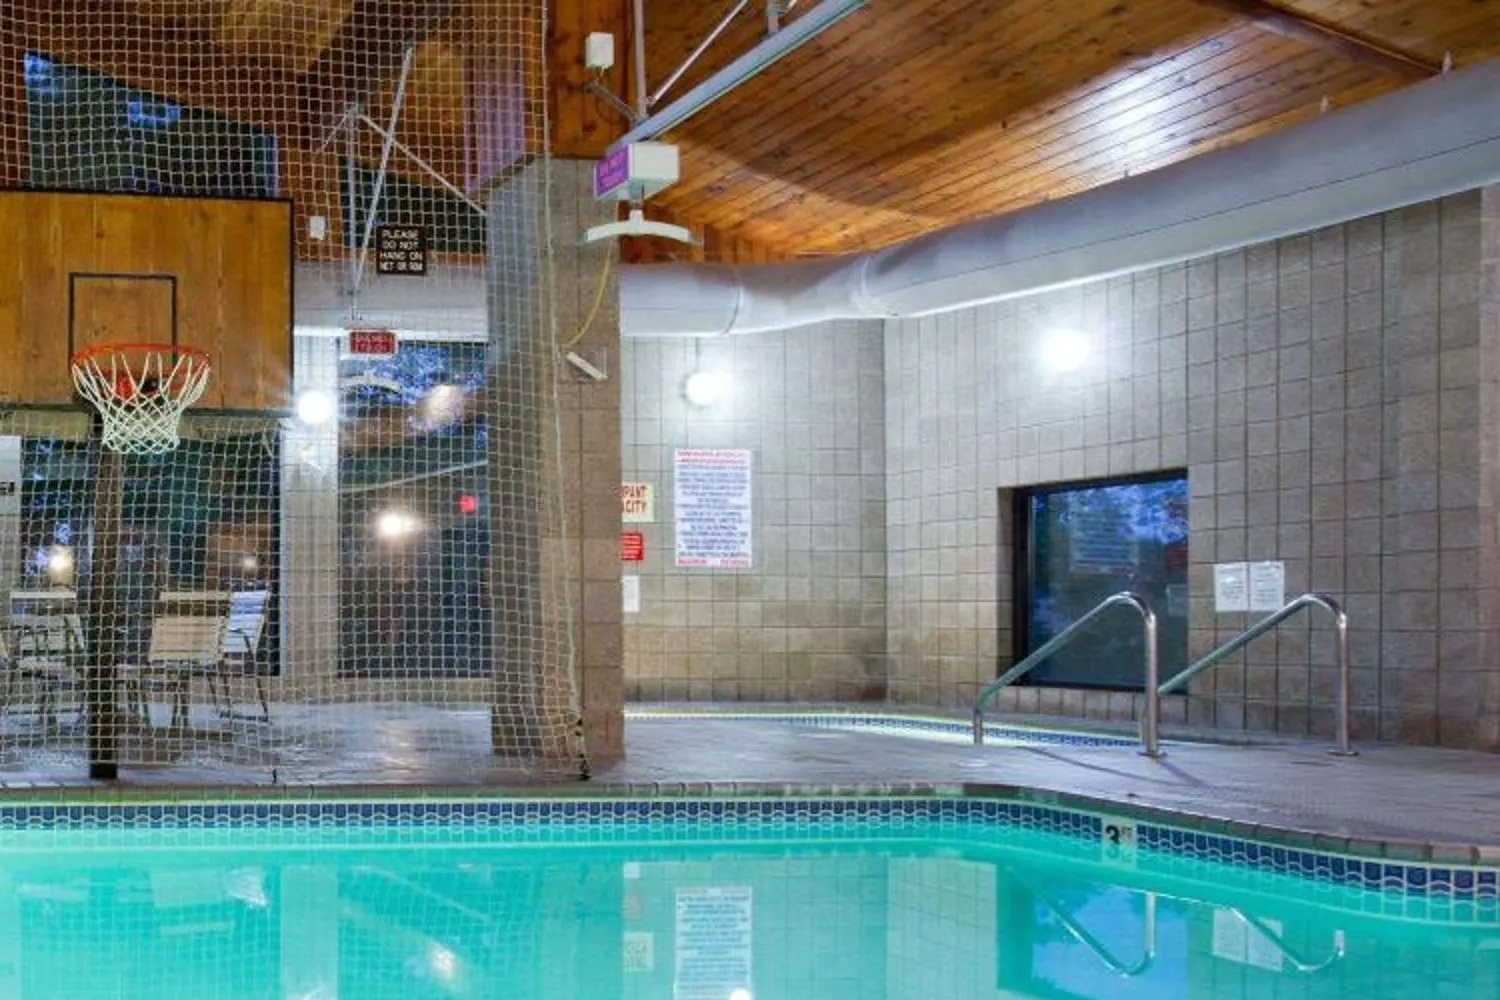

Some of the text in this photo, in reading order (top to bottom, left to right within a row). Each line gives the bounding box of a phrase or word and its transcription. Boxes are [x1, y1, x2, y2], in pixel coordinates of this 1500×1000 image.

[381, 229, 419, 240] PLEASE
[381, 240, 419, 250] DO NOT
[380, 251, 422, 260] HANG ON
